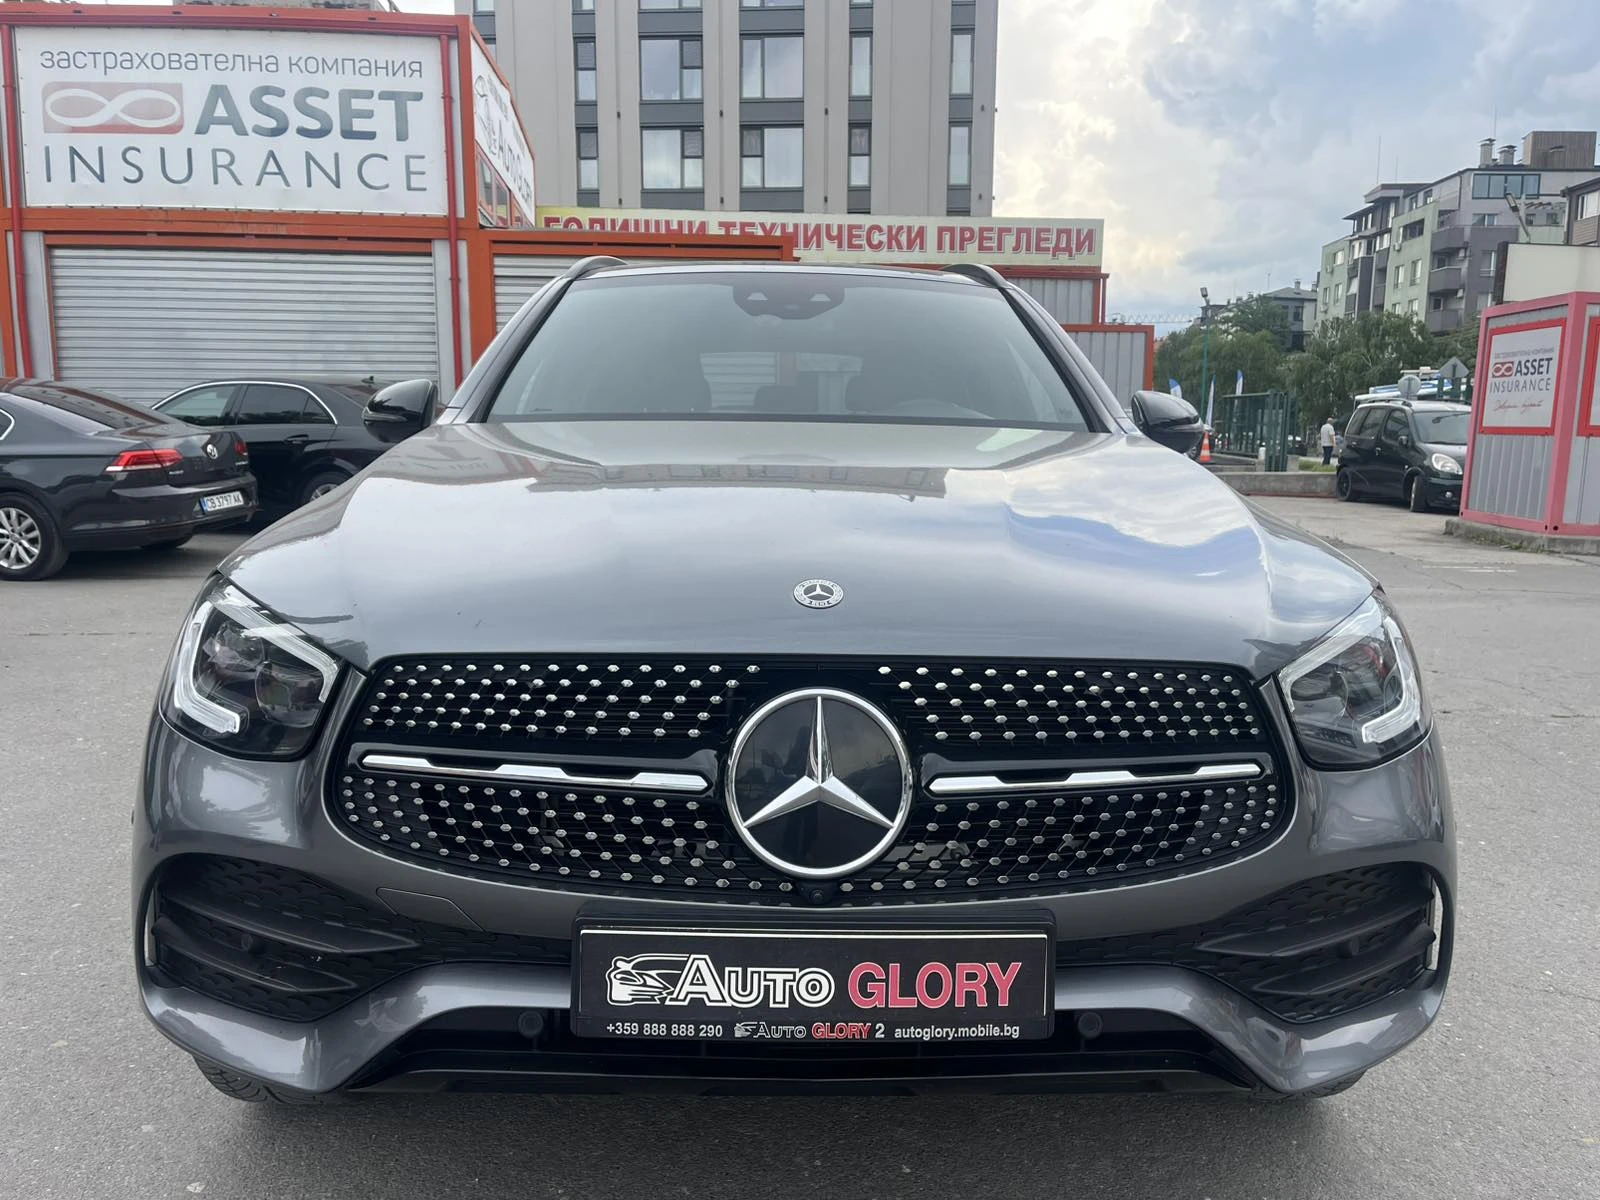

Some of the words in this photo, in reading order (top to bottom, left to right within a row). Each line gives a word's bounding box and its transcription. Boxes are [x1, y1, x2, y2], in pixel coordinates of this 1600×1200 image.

[40, 50, 279, 76] застрахователна
[289, 55, 423, 78] компания
[194, 84, 424, 142] ASSET
[44, 145, 428, 192] INSURANCE
[936, 225, 1096, 259] ПРЕГЛЕДИ
[1514, 357, 1553, 377] ASSET
[1489, 377, 1551, 394] INSURANCE
[847, 961, 1023, 1010] GLORY
[606, 1022, 639, 1036] +359
[643, 1023, 668, 1036] 888
[671, 1024, 696, 1037] 888
[699, 1024, 723, 1038] 290
[811, 1022, 872, 1040] GLORY
[875, 1023, 886, 1039] 2
[894, 1024, 1021, 1041] autoglory.mobile.bg
